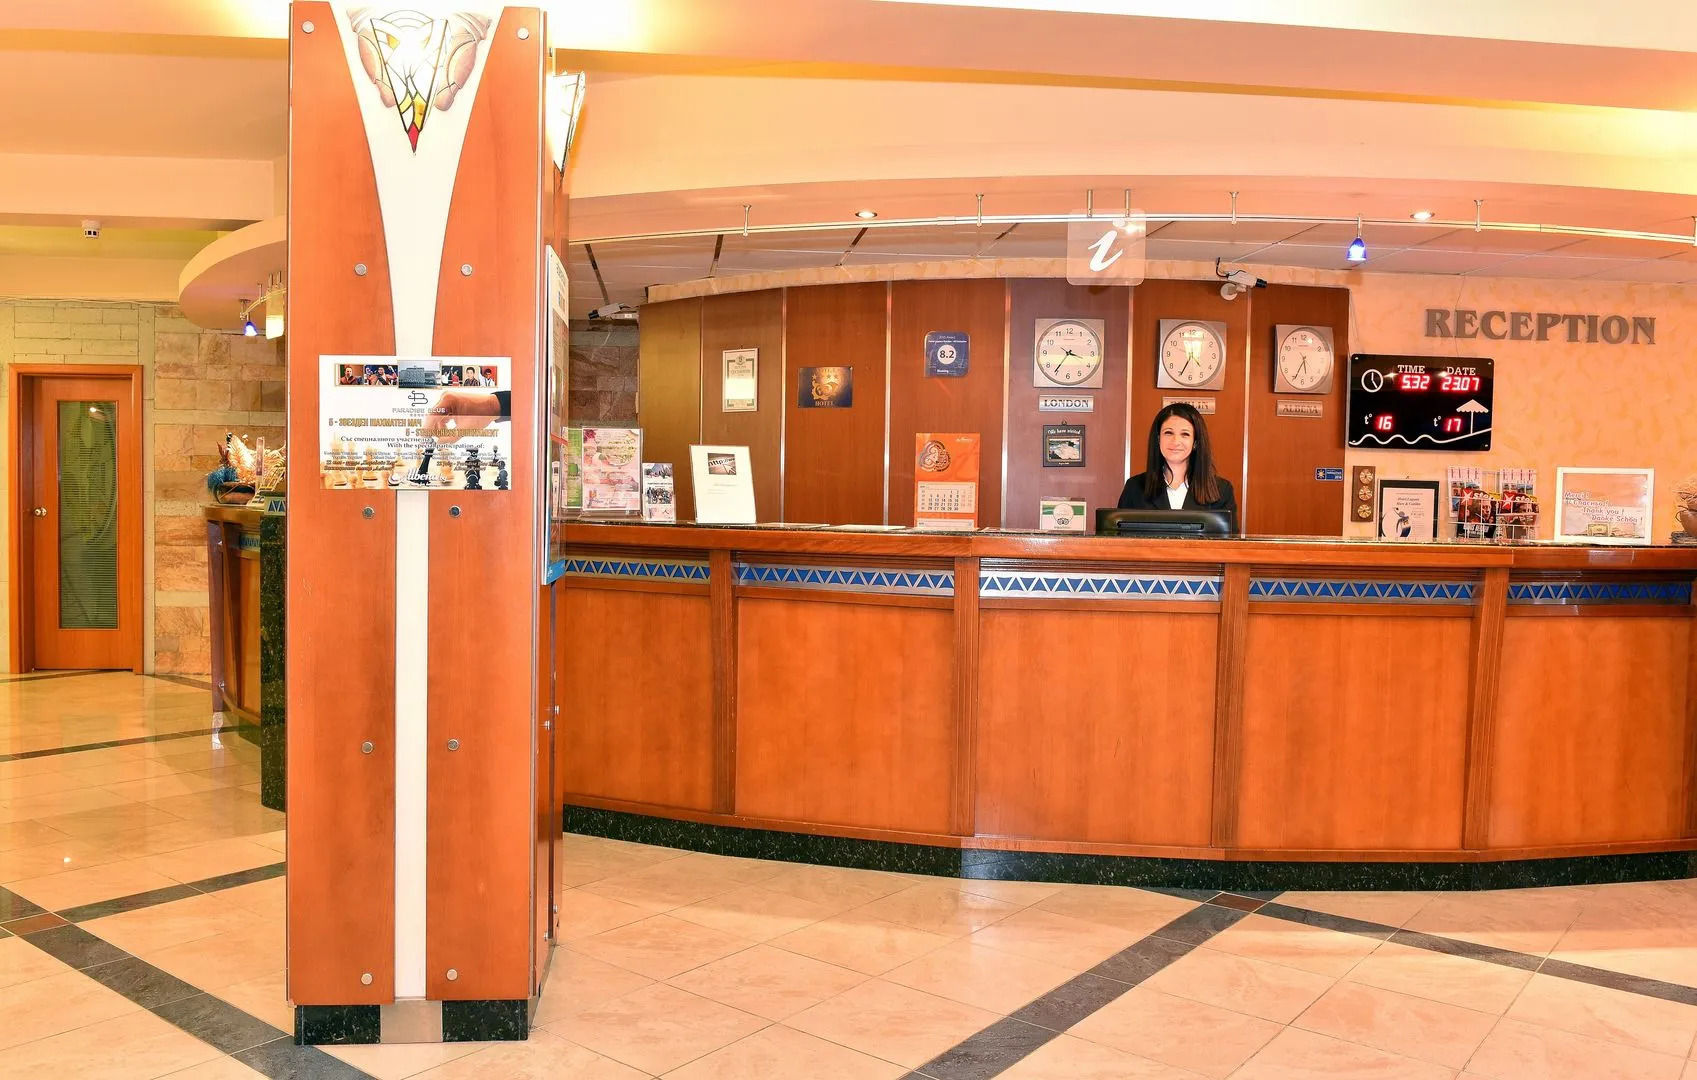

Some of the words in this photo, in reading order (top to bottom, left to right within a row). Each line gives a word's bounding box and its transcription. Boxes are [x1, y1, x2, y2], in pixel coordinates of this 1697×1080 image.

[1424, 308, 1656, 345] RECEPTION
[939, 350, 955, 359] 8.2
[1397, 364, 1426, 374] TIME
[1446, 366, 1476, 376] DATE
[1044, 399, 1089, 408] LONDON
[1378, 416, 1393, 430] 16
[1446, 418, 1462, 432] 17
